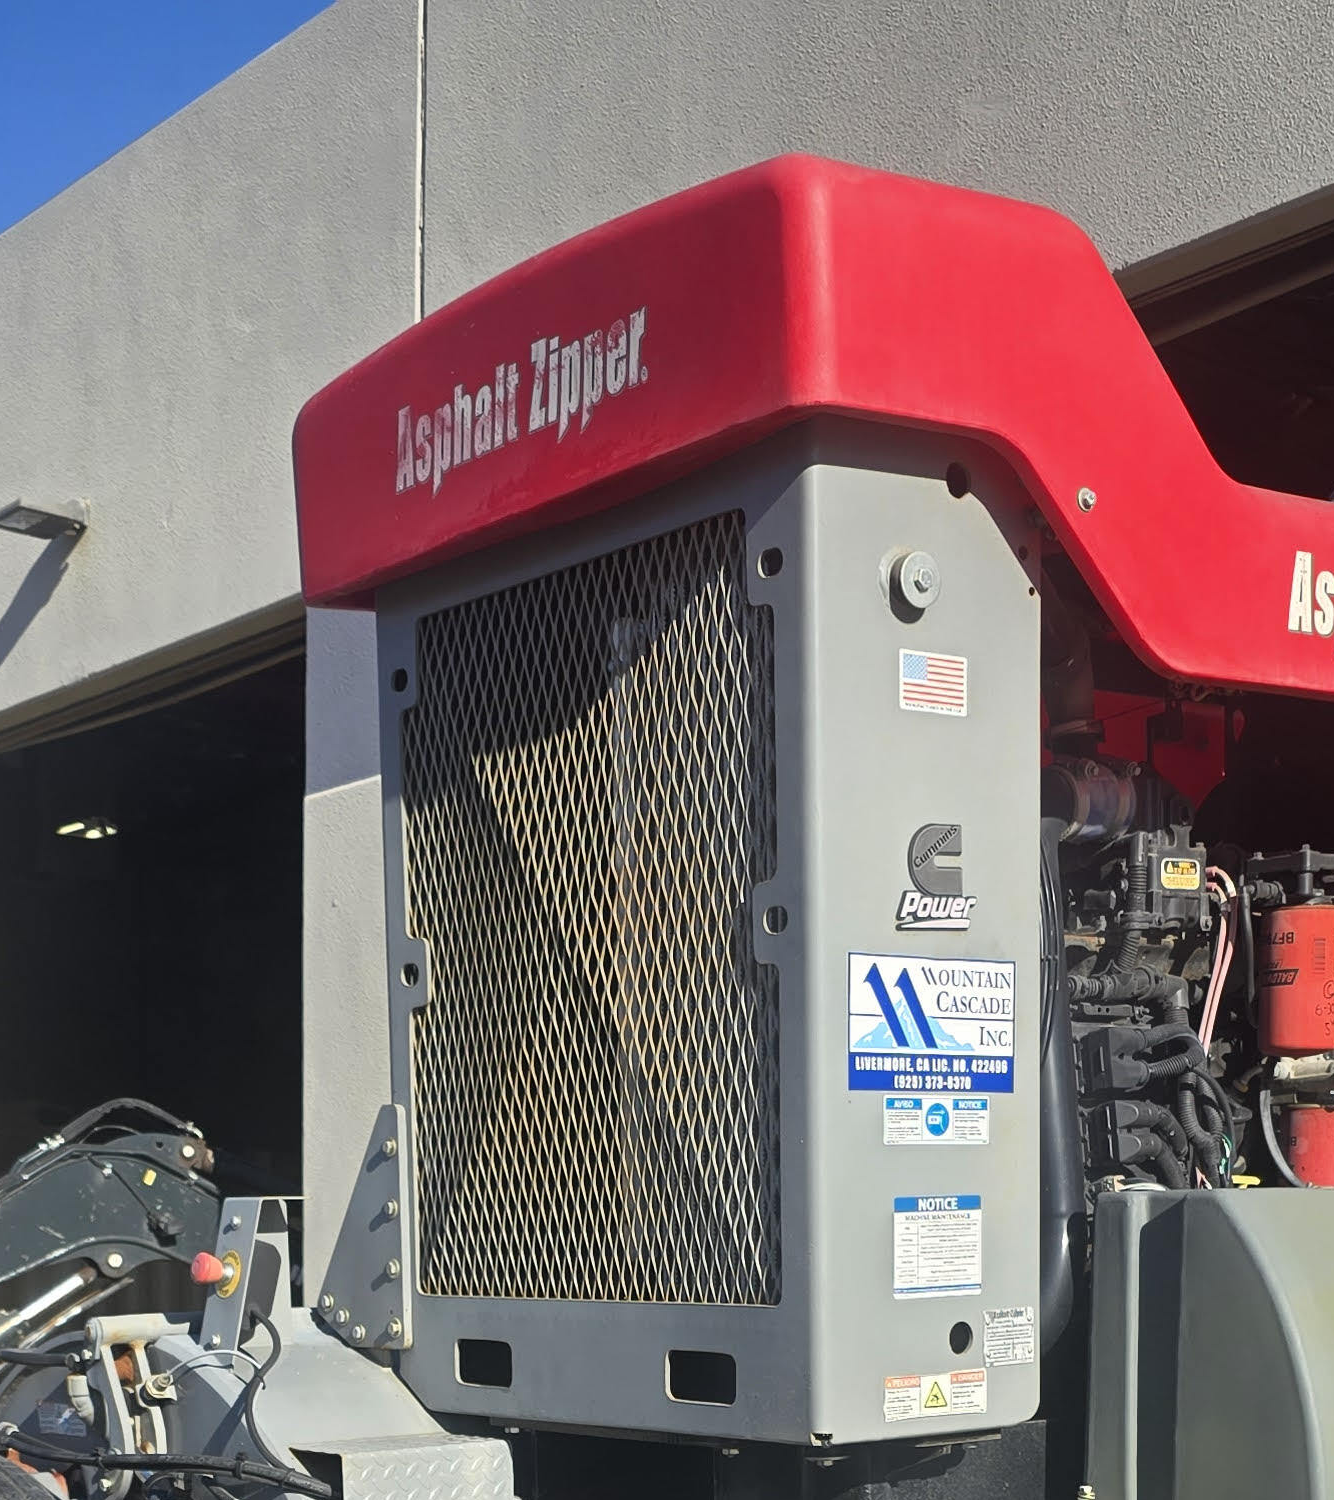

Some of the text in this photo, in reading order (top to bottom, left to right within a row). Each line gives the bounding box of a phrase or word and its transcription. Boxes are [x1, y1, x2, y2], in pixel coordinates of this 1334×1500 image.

[396, 362, 519, 498] Asphalt
[914, 824, 957, 868] Cummins
[900, 891, 976, 919] Power
[921, 966, 1012, 989] MOUNTAIN
[936, 991, 1011, 1015] CASCADE
[979, 1026, 1011, 1047] INC.
[854, 1056, 1008, 1074] LIVERMORE, CA LIC. NO. 422496
[918, 1197, 958, 1211] NOTICE
